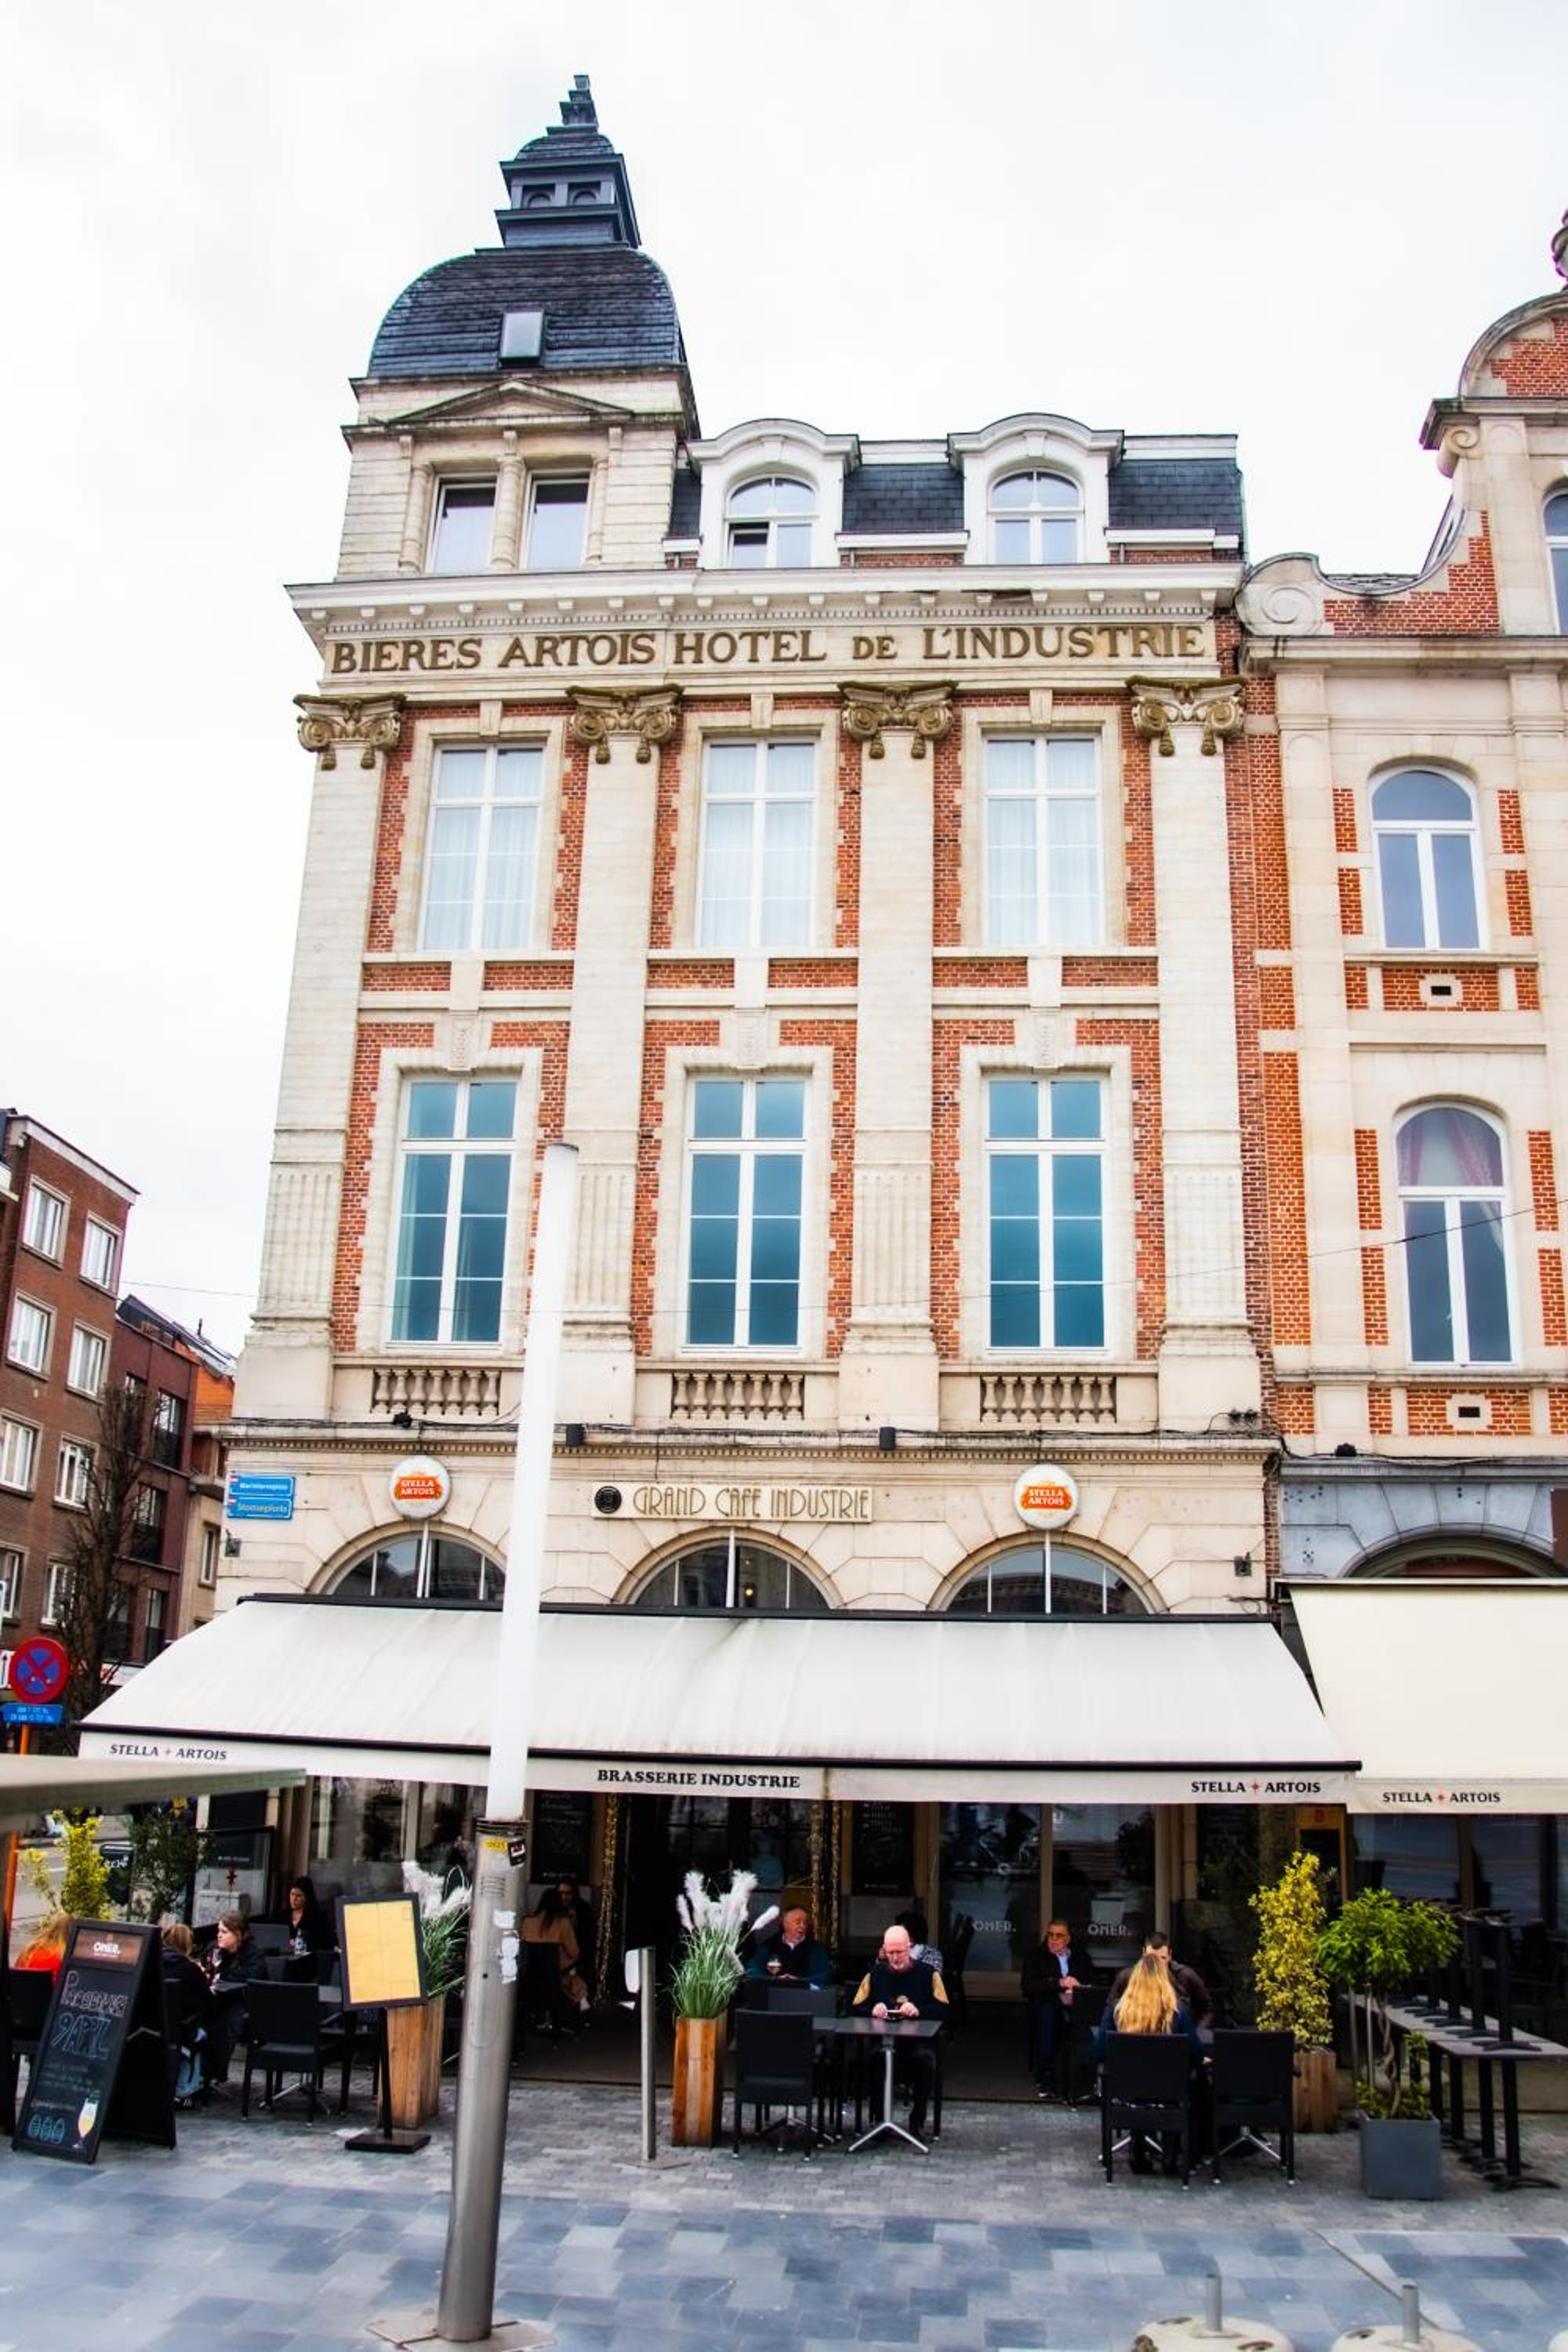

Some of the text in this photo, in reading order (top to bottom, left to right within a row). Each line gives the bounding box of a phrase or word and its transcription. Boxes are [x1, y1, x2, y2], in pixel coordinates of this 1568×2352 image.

[331, 626, 1205, 673] BIERES ARTOIS HOTEL DE L'INDUSTRIE
[632, 1486, 706, 1516] GRAND
[770, 1487, 869, 1519] INDUSTRIE
[110, 1743, 227, 1761] STELLA ARTOIS
[597, 1769, 800, 1788] BRASSERIE INDUSTRIE
[1190, 1780, 1321, 1794] STELLA ARTOIS
[1381, 1791, 1501, 1803] STELLA ARTOIS
